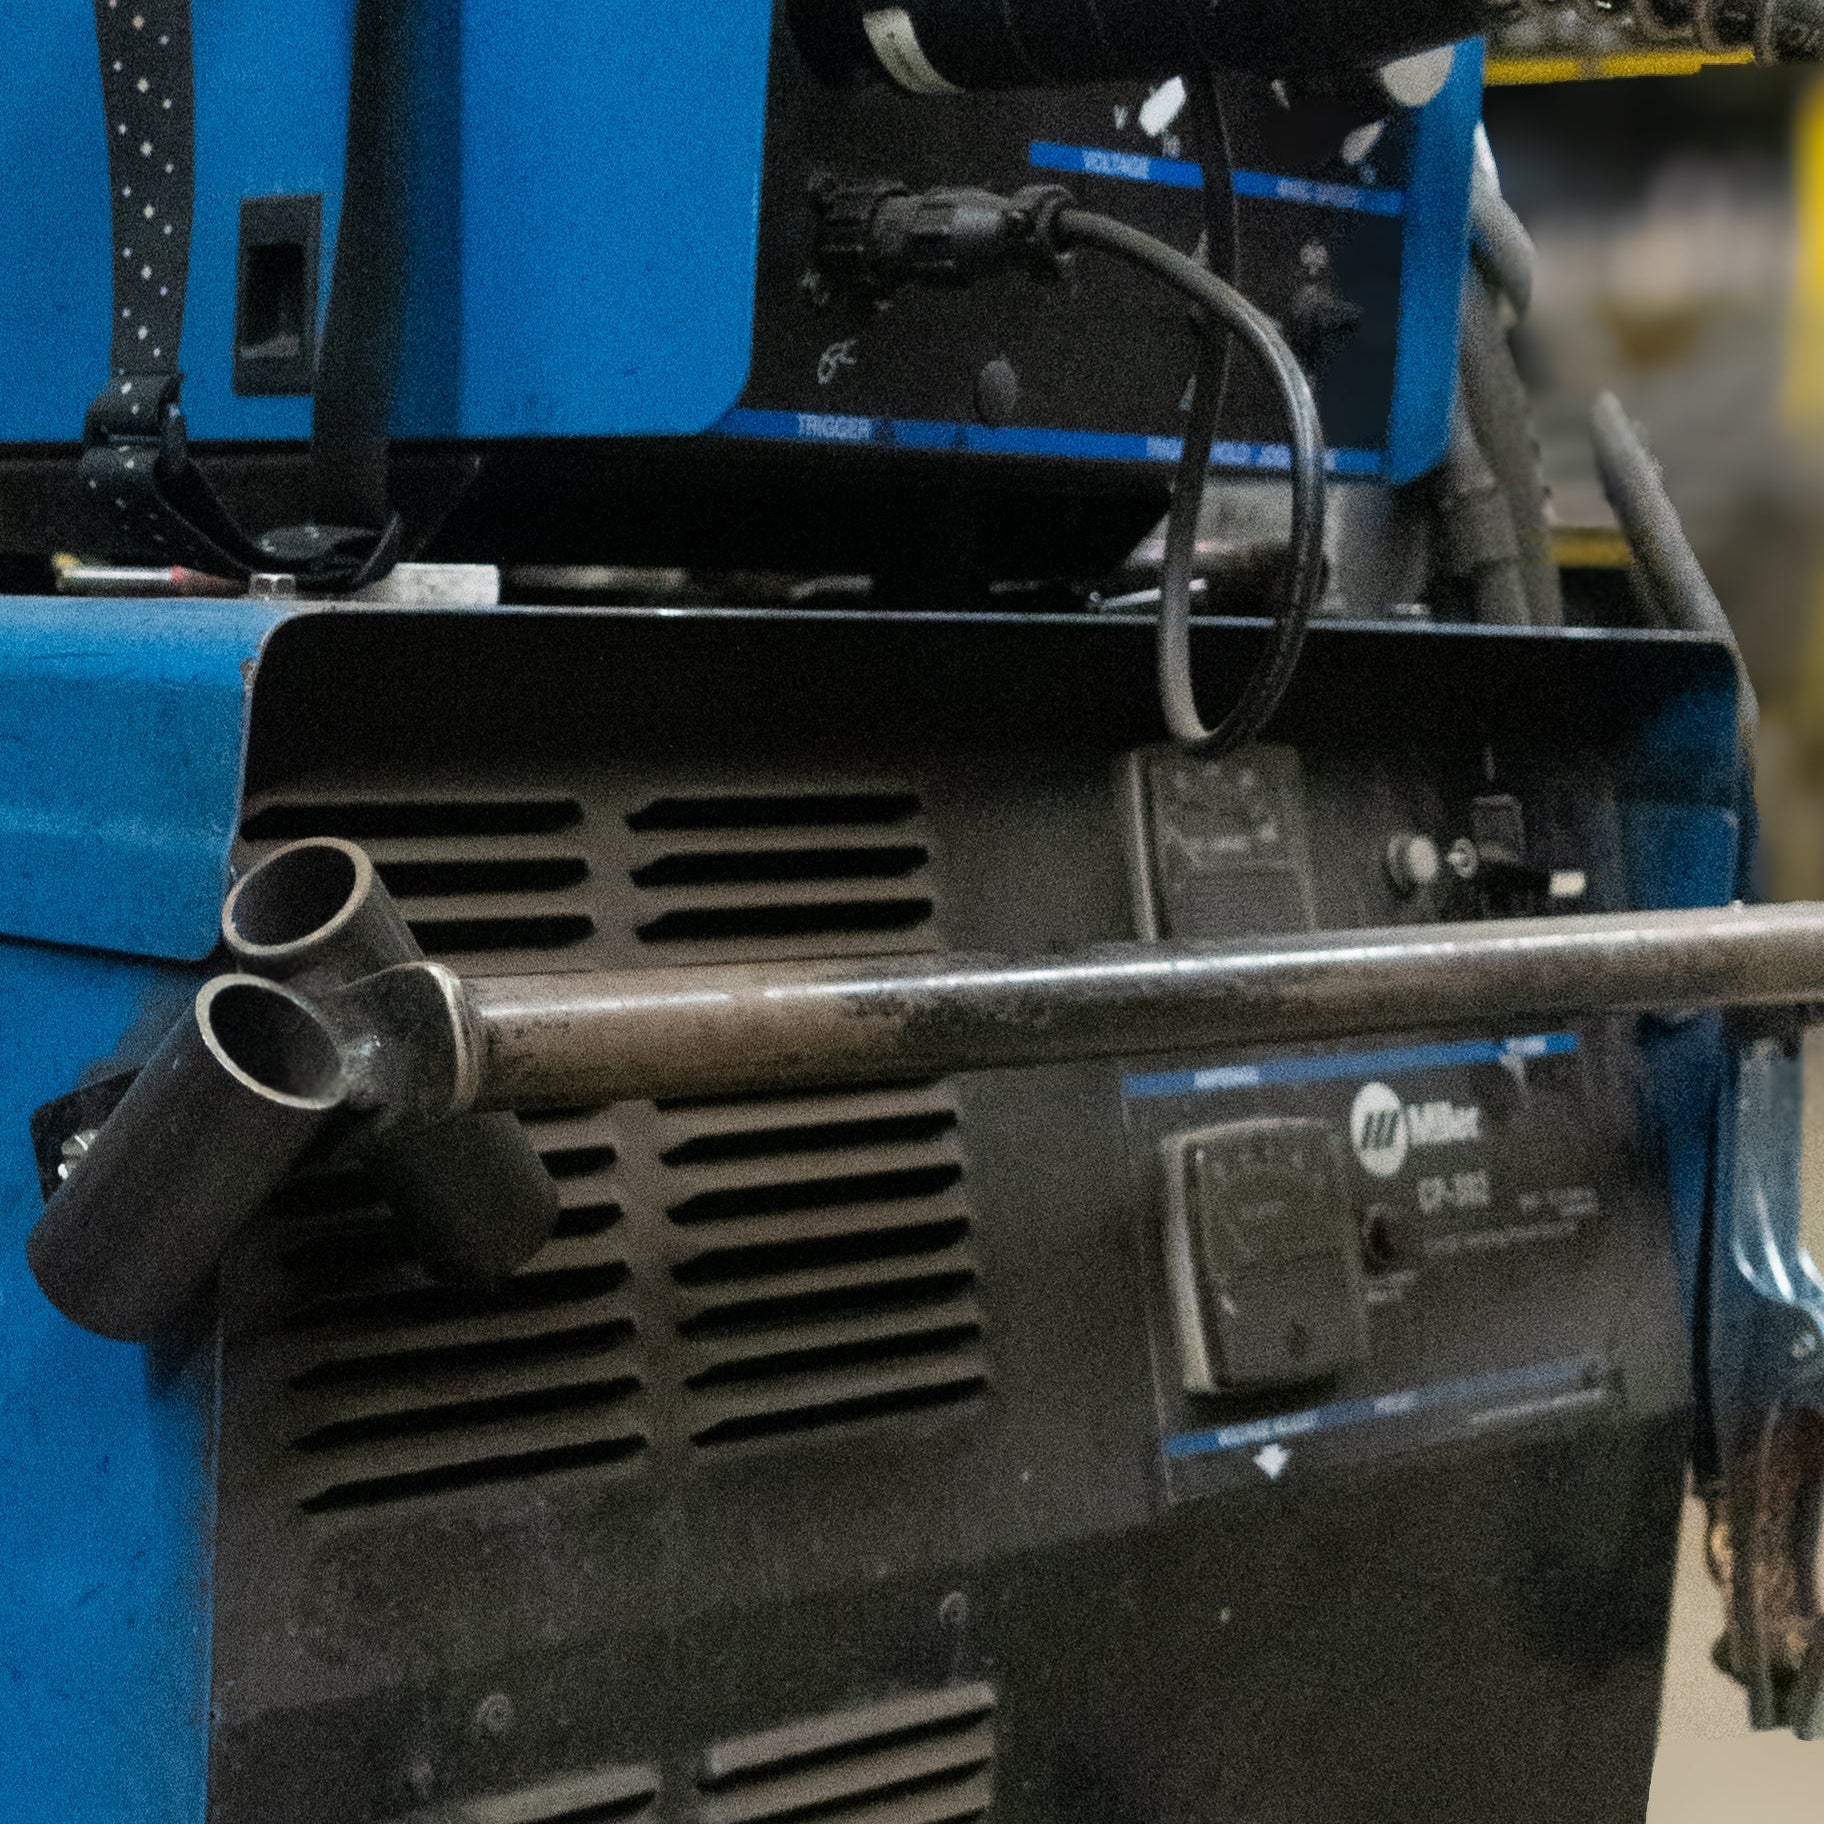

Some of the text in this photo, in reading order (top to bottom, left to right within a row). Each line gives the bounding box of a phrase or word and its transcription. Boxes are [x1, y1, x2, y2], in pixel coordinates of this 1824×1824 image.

[1083, 150, 1150, 180] VOLTAGE
[796, 412, 872, 440] TRIGGER
[1407, 1100, 1482, 1147] Miller
